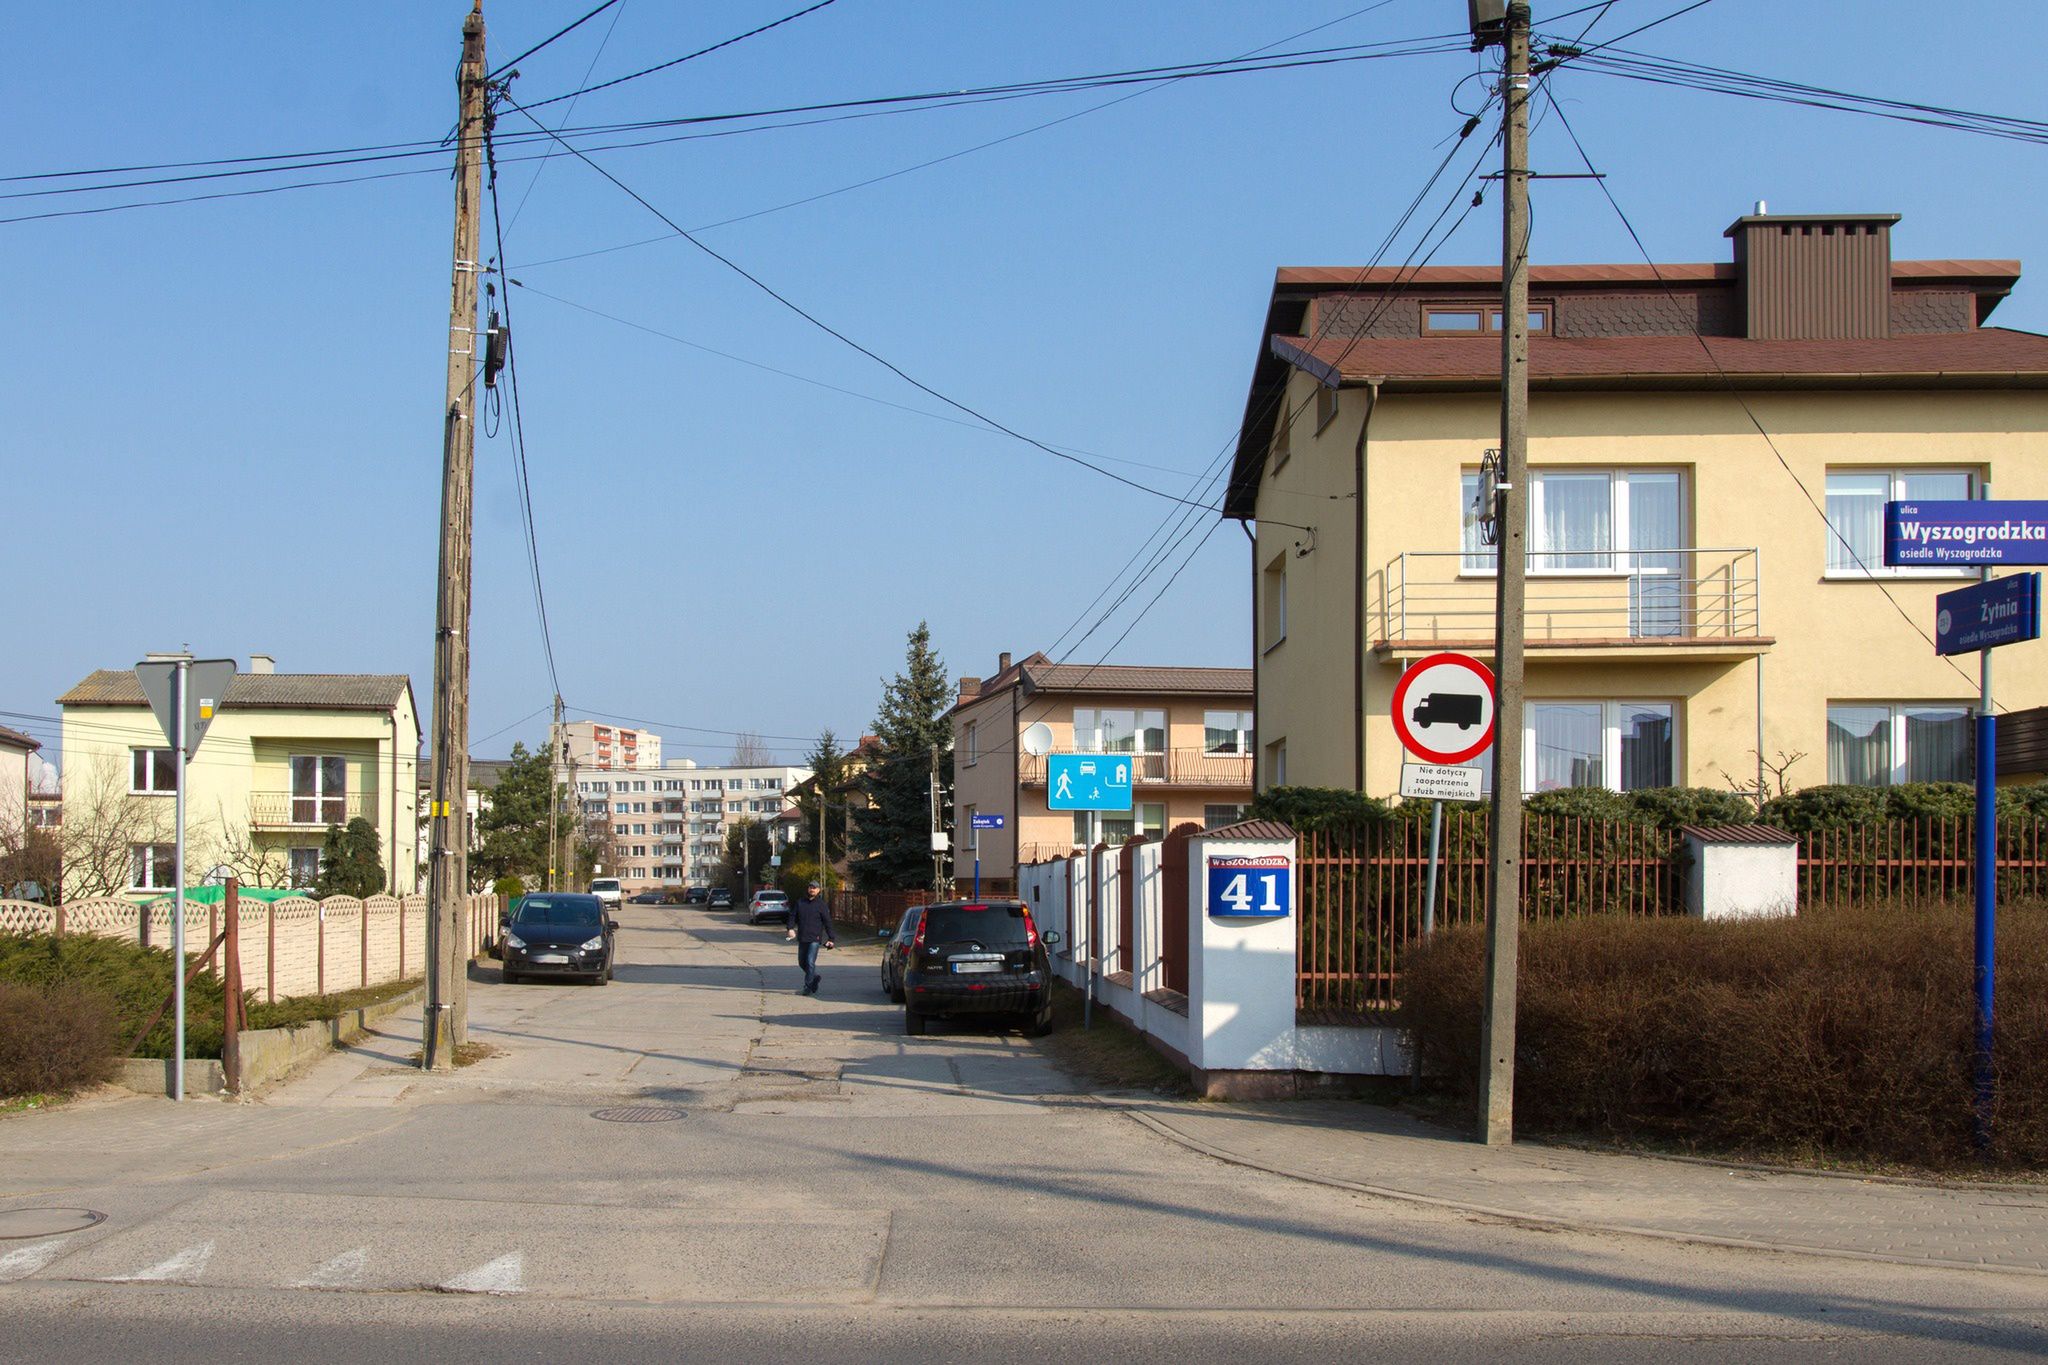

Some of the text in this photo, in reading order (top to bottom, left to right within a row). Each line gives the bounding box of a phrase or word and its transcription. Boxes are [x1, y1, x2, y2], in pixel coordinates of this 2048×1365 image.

[1900, 506, 1918, 514] ulica
[1900, 521, 2046, 544] Wyszogrodzka
[1900, 547, 2002, 560] osiedle Wyszogrodzka
[1981, 598, 2017, 624] Żytnia
[1959, 625, 2017, 644] osiedle Wyszogrodzka
[1419, 766, 1467, 777] Nie dotyczy
[1415, 778, 1469, 786] zaopatrzenia
[1413, 787, 1434, 795] służb
[1437, 789, 1475, 798] miejskich
[1220, 873, 1281, 911] 41
